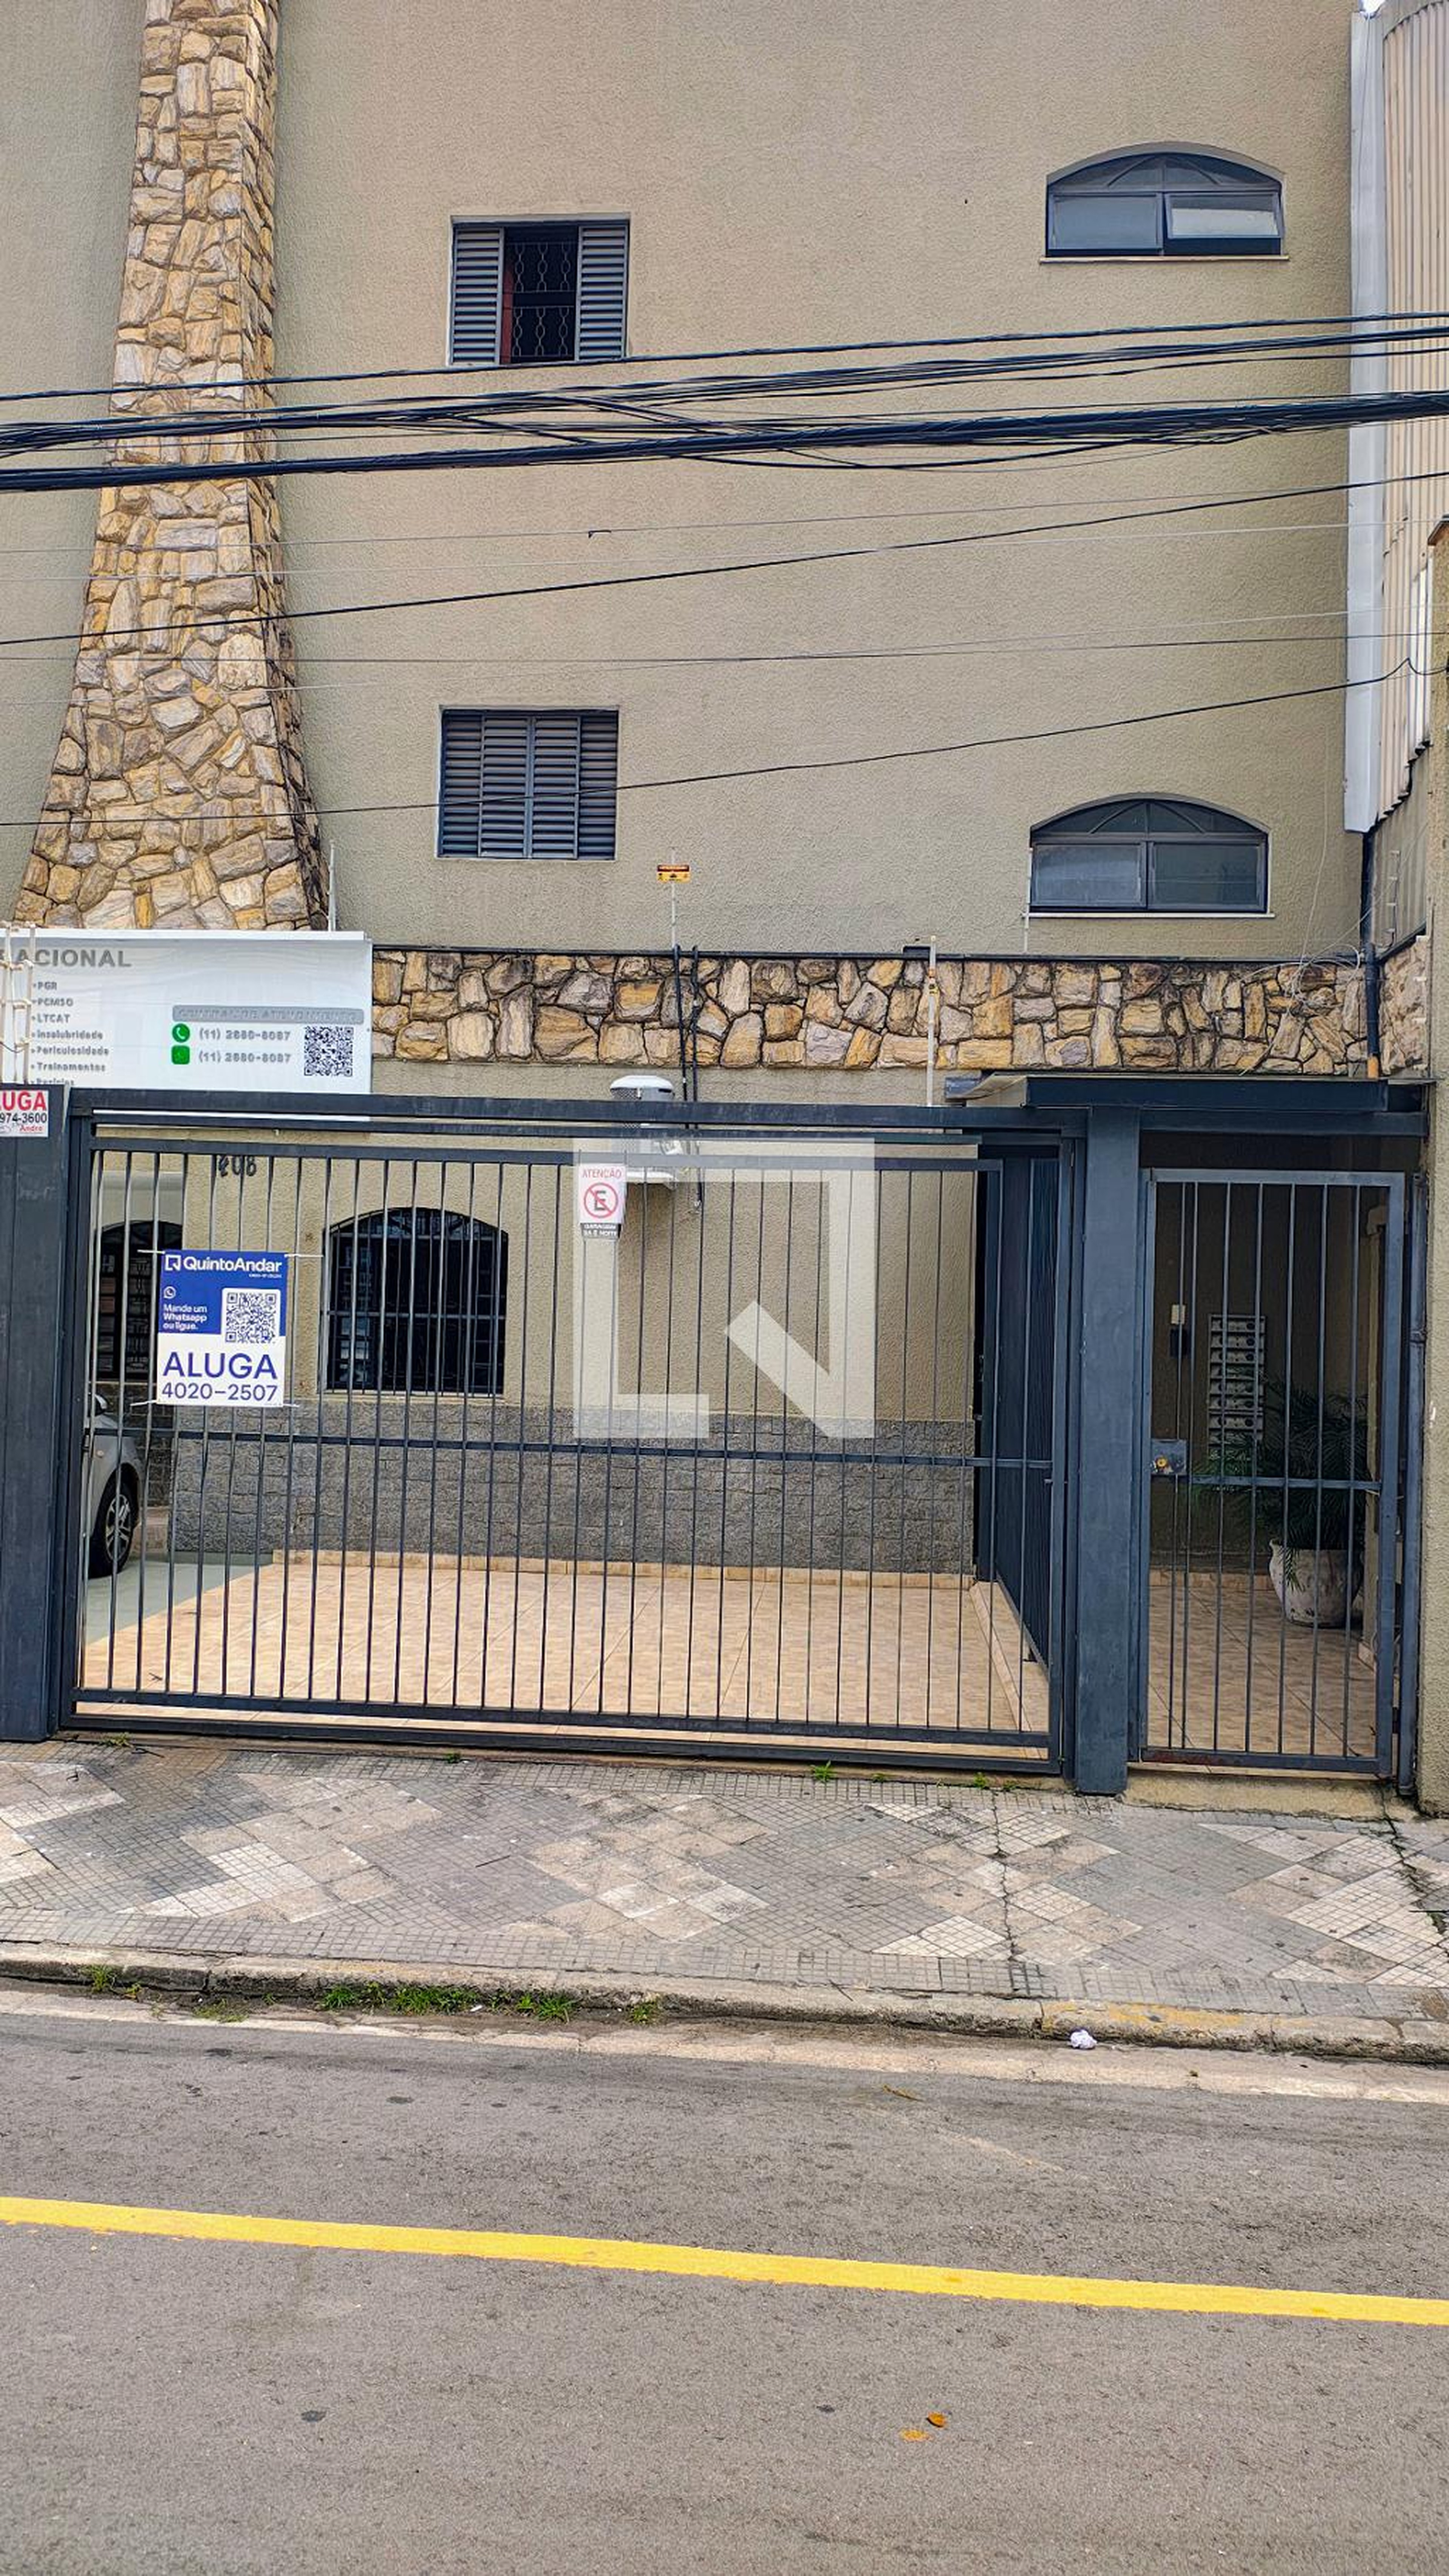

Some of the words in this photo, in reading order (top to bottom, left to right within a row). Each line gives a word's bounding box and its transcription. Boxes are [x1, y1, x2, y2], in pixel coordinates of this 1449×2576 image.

[0, 948, 131, 967] ACIONAL
[37, 1014, 70, 1023] LTCAT
[200, 1027, 221, 1040] (11)
[199, 1050, 222, 1062] (11)
[0, 1090, 46, 1111] UGA
[183, 1256, 282, 1272] QuintoAndar
[163, 1304, 192, 1313] Mande
[163, 1313, 208, 1323] Whatsapp
[162, 1351, 278, 1380] ALUGA
[162, 1382, 278, 1401] 4020-2507
